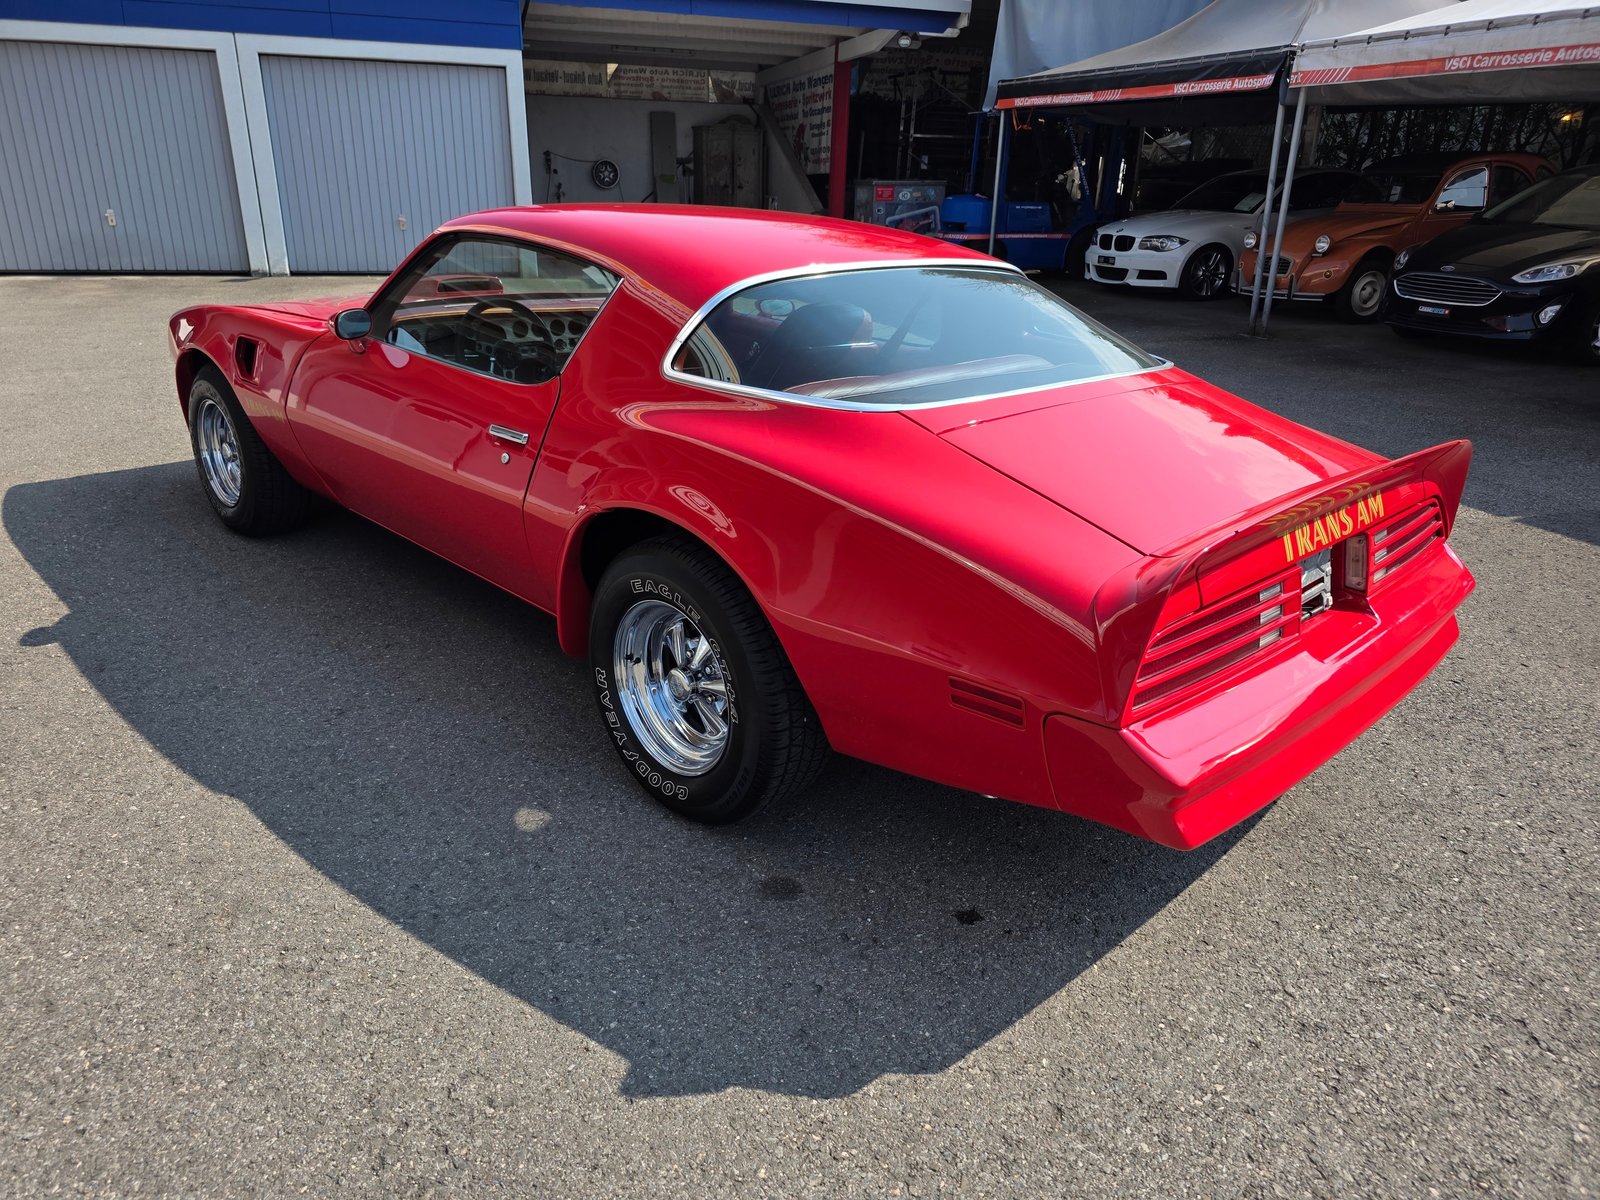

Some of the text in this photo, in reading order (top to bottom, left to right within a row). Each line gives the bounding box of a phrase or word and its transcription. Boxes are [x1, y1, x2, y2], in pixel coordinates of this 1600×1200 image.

[1444, 46, 1600, 72] VSCI Carrosserie Autos
[792, 80, 806, 93] Auto
[807, 73, 833, 89] Wangen
[1174, 84, 1188, 94] VSCI
[1189, 79, 1232, 92] Carrosserie
[1277, 490, 1385, 563] TRANS AM
[630, 578, 702, 624] EAGLE
